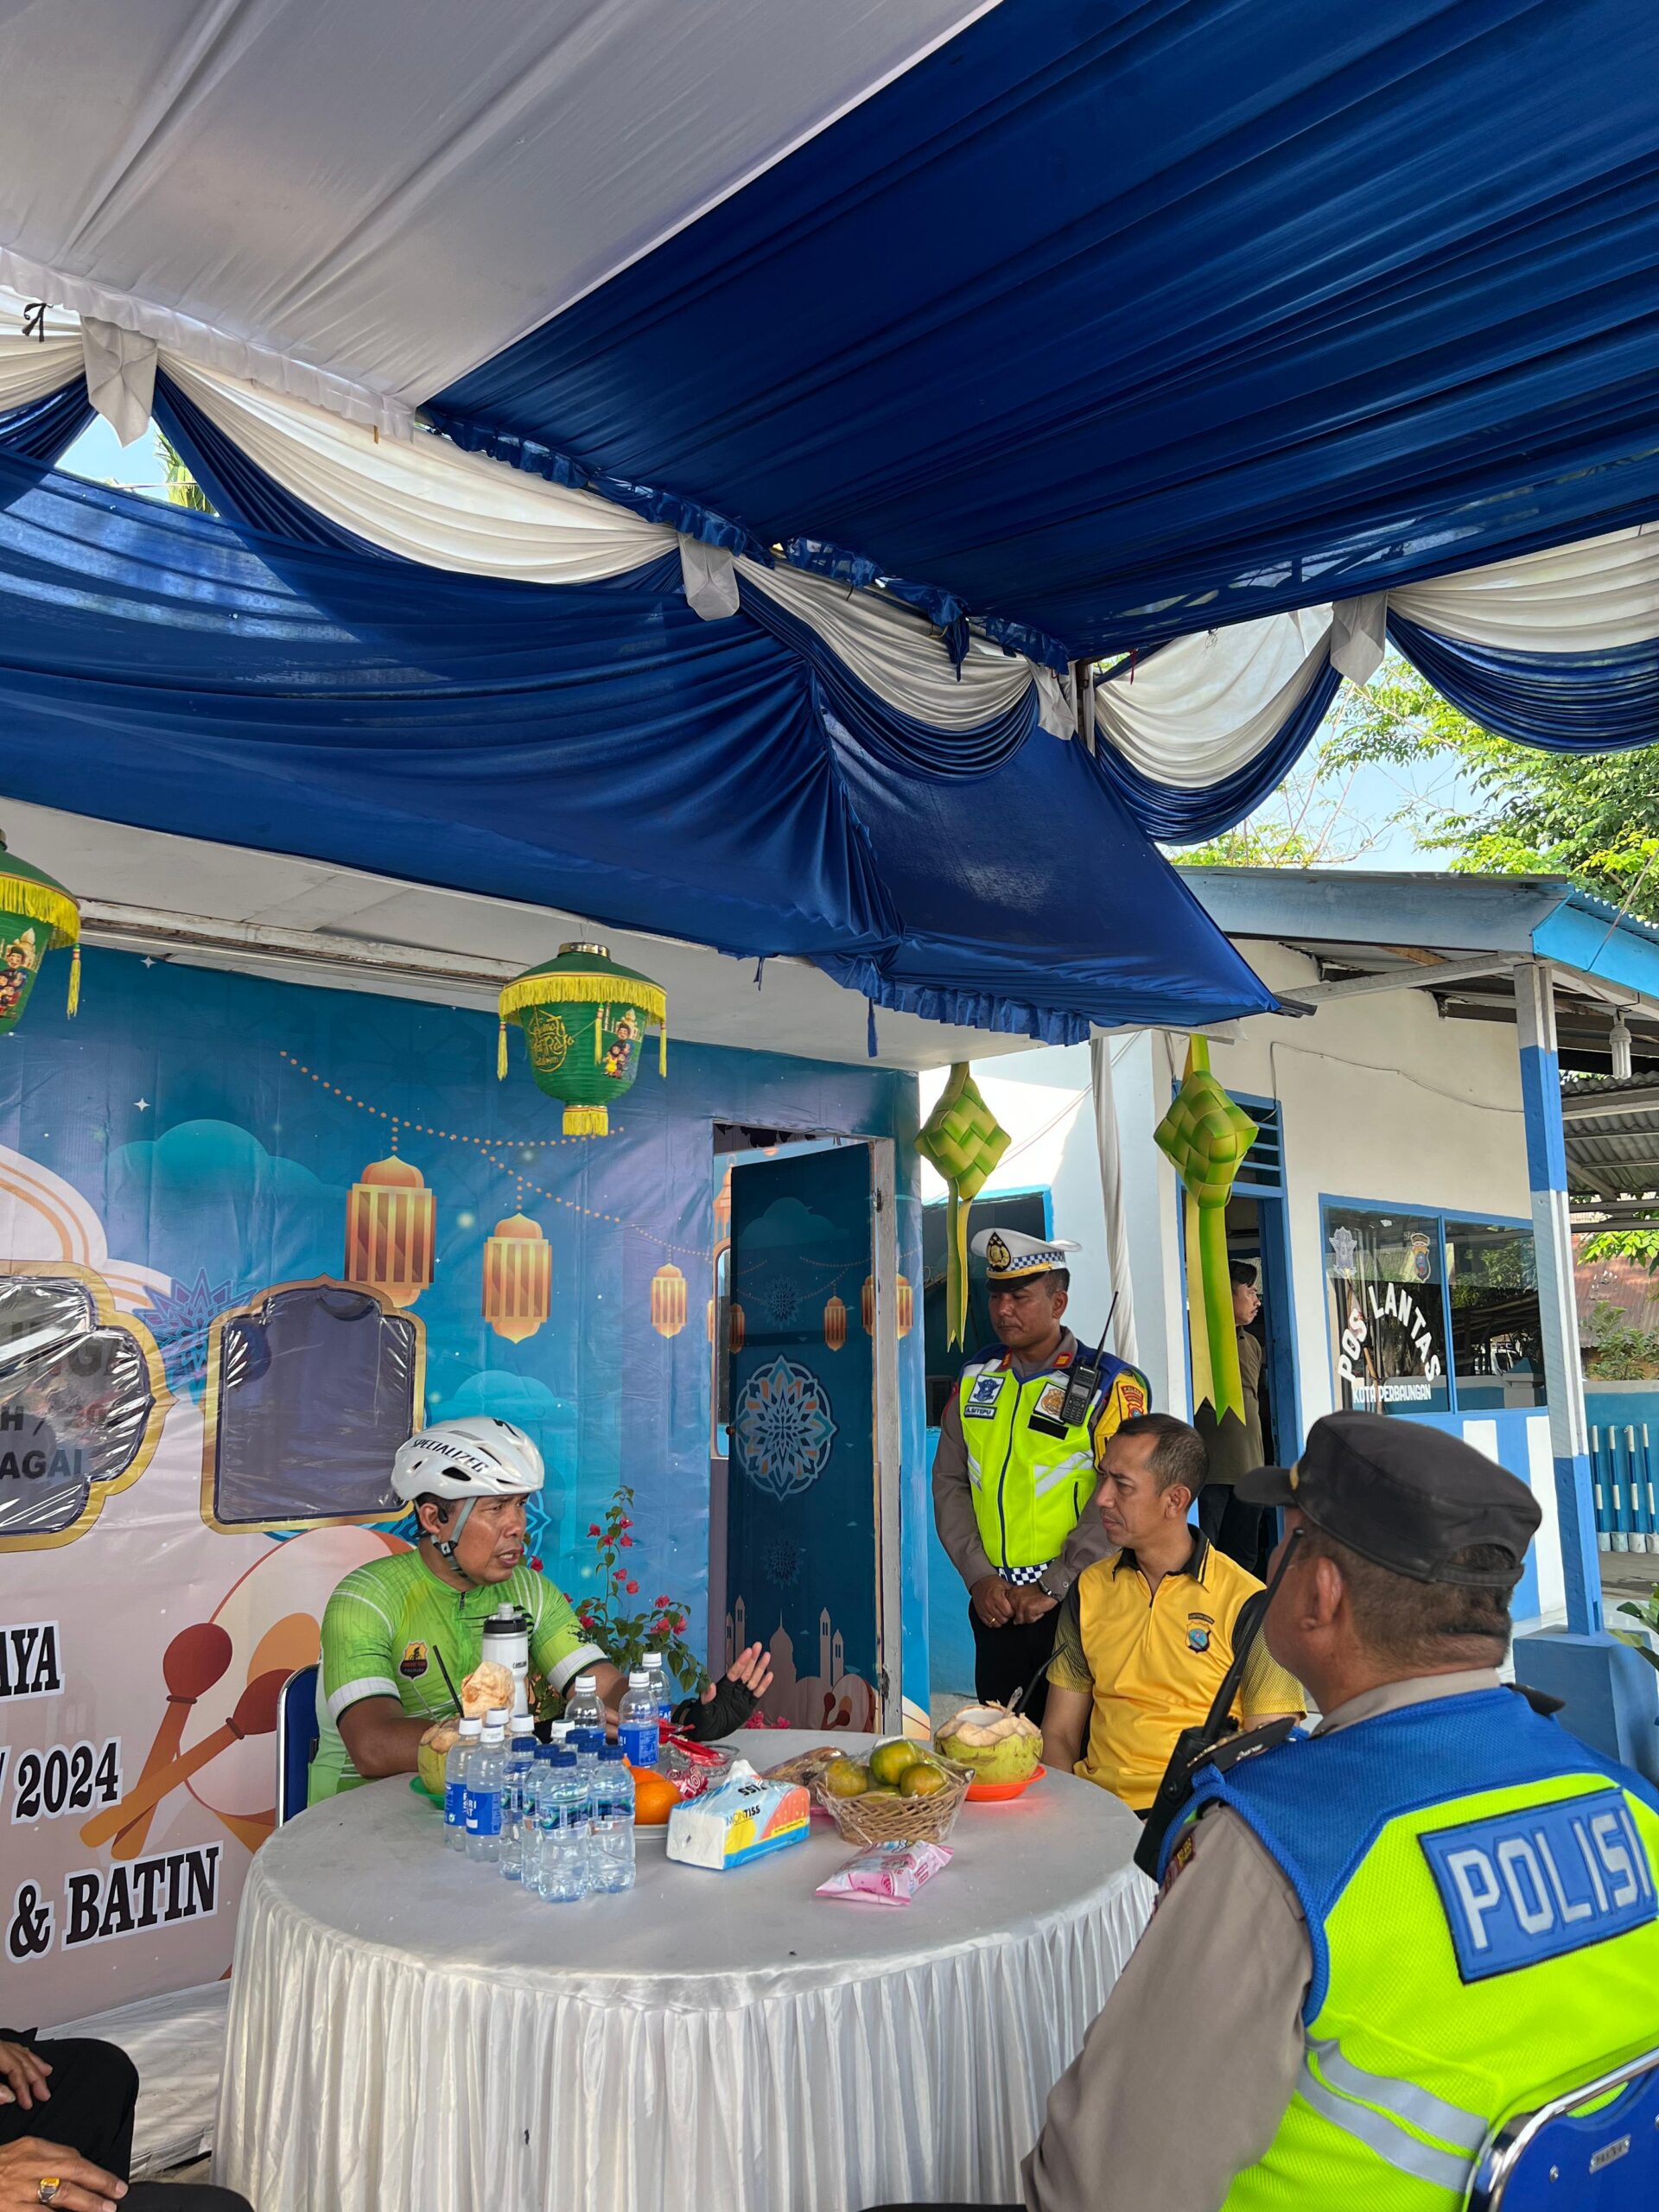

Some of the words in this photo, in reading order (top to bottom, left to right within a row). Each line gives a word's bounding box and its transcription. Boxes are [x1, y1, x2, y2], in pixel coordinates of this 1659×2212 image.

[1338, 1308, 1368, 1382] POS
[1368, 1282, 1441, 1382] LANTAS
[1353, 1386, 1376, 1404] KOTA
[1378, 1384, 1432, 1402] PERBAUNGAN
[16, 1742, 119, 1819] 2024
[726, 1805, 761, 1827] MONTISS
[10, 1884, 51, 1958] &
[66, 1846, 220, 1946] BATIN
[1447, 1809, 1653, 1950] POLISI
